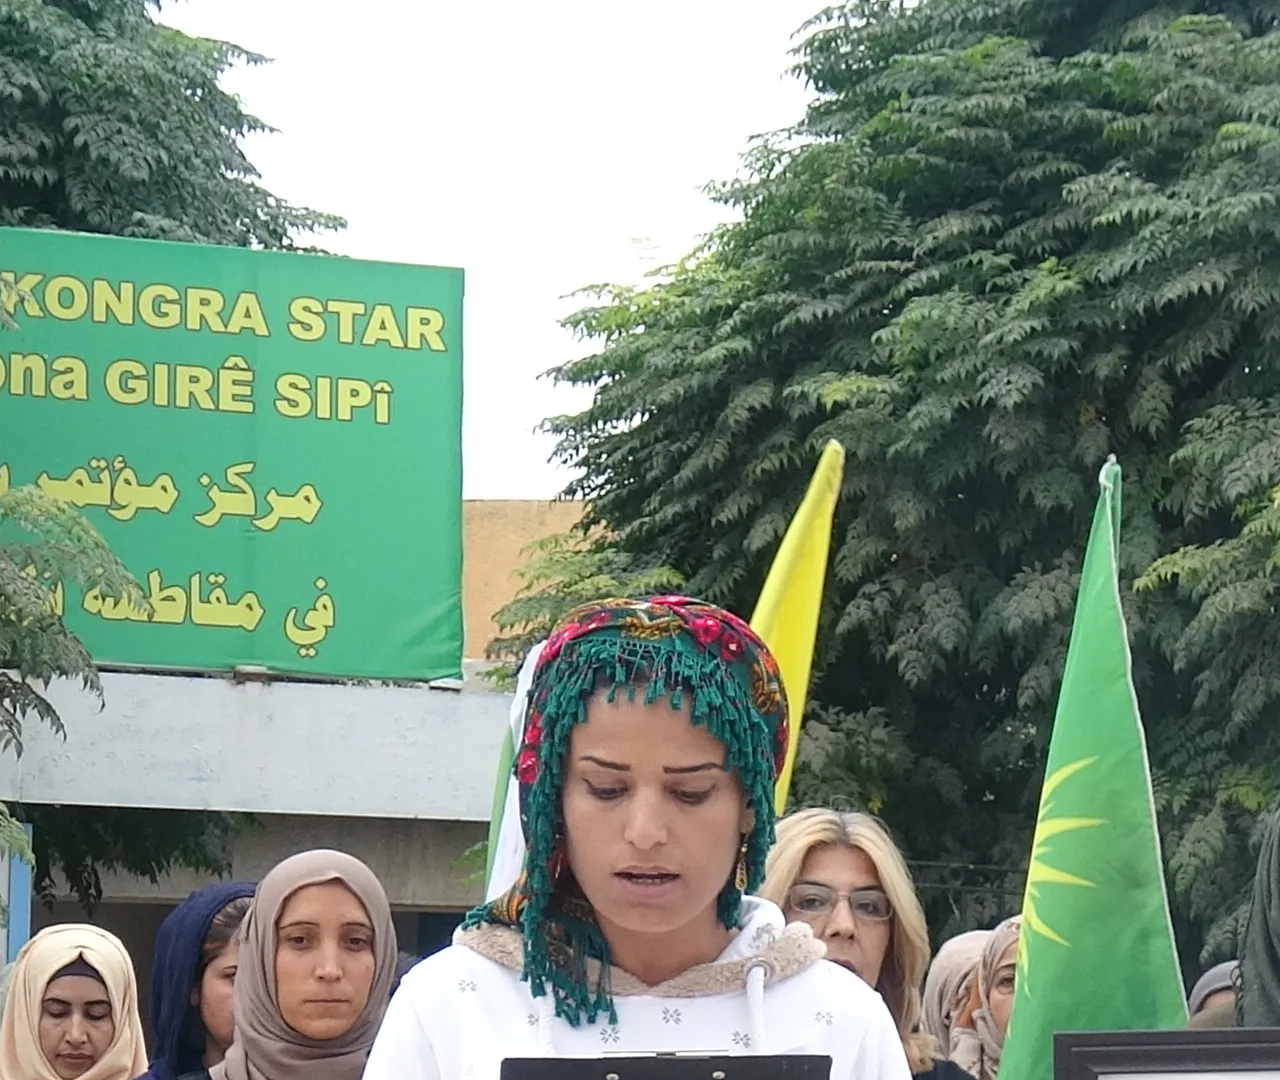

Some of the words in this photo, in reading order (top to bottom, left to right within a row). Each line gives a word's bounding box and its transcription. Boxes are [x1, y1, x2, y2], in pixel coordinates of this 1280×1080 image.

[0, 269, 271, 338] KONGRA
[287, 296, 448, 353] STAR
[104, 353, 256, 414] GIRÊ
[36, 454, 180, 522] مؤتمر
[193, 460, 323, 532] مركز
[284, 576, 336, 658] في
